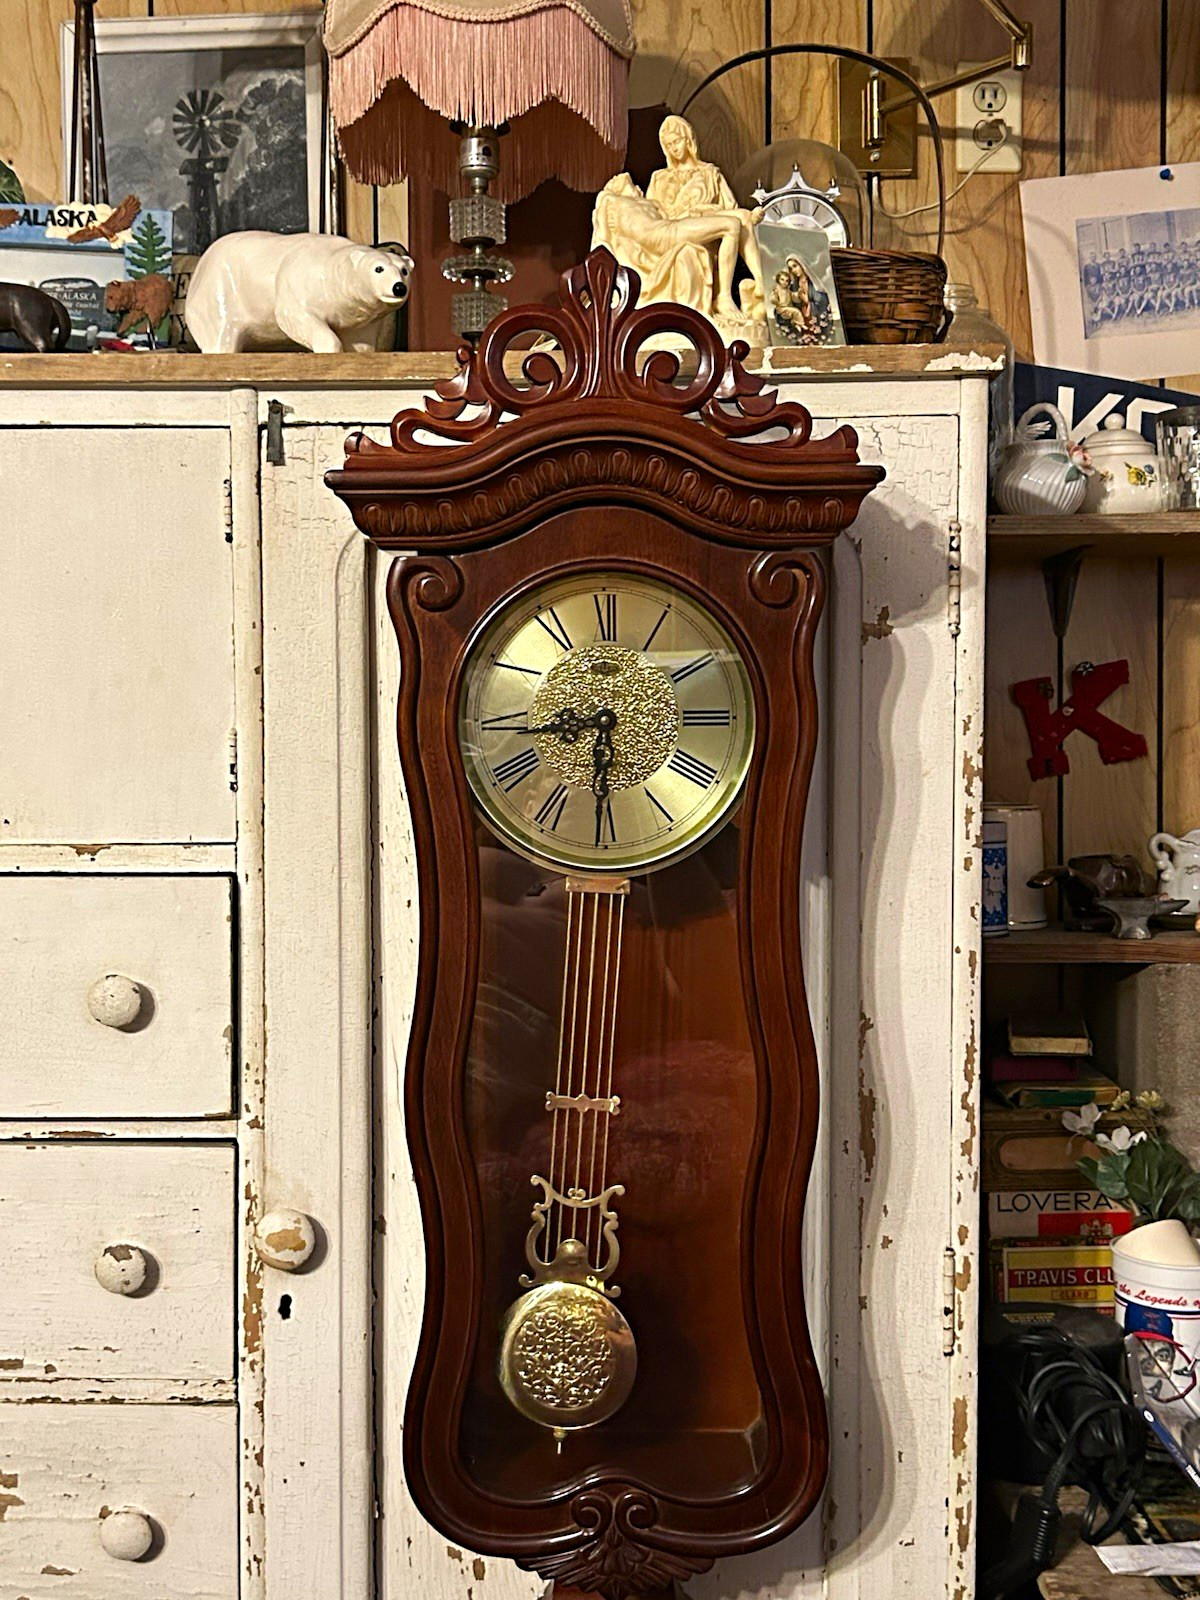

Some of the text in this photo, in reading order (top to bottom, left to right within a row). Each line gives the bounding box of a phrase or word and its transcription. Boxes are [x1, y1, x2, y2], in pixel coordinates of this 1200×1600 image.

[19, 208, 98, 228] ALASKA
[593, 594, 617, 642] XII
[682, 710, 730, 726] III
[997, 1192, 1113, 1213] LOVERA
[1013, 1268, 1078, 1286] TRAVIS
[1119, 1283, 1132, 1296] the
[1134, 1289, 1188, 1306] Legends
